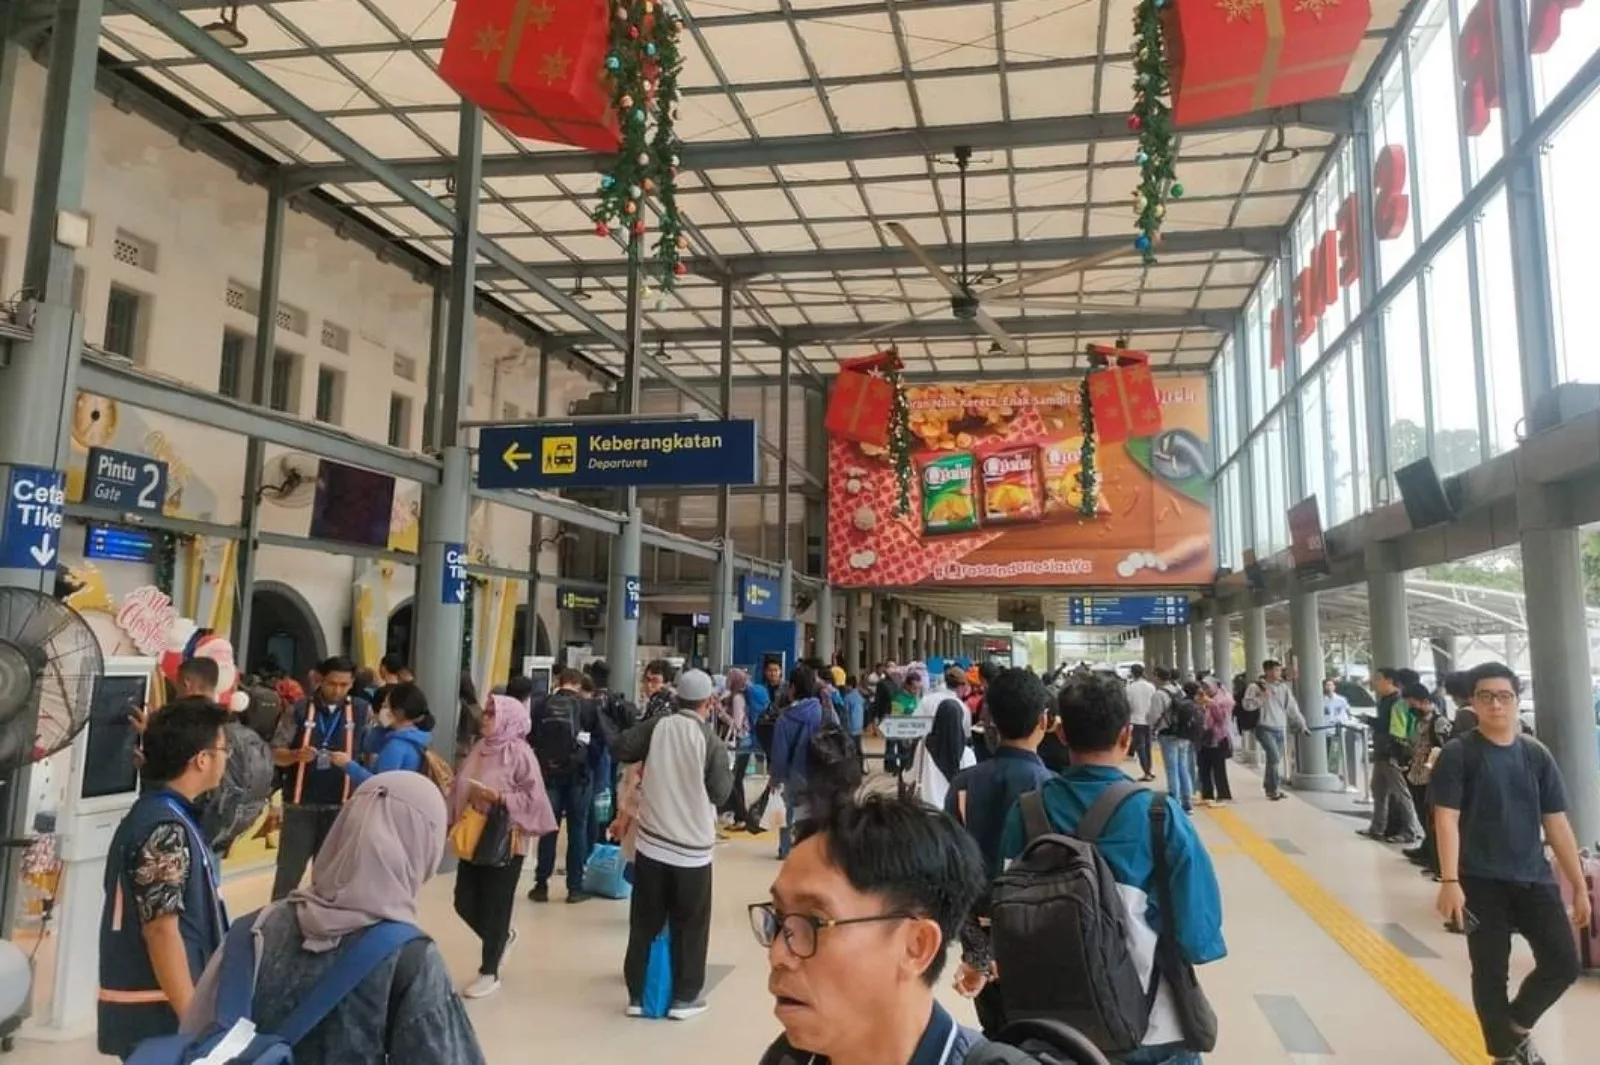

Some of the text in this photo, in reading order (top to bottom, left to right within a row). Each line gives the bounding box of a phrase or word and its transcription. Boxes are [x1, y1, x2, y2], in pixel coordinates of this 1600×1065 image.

[590, 432, 722, 453] Keberangkatan
[588, 457, 648, 470] Departures
[98, 454, 137, 480] Pintu
[137, 463, 160, 509] 2
[94, 483, 121, 502] Gate
